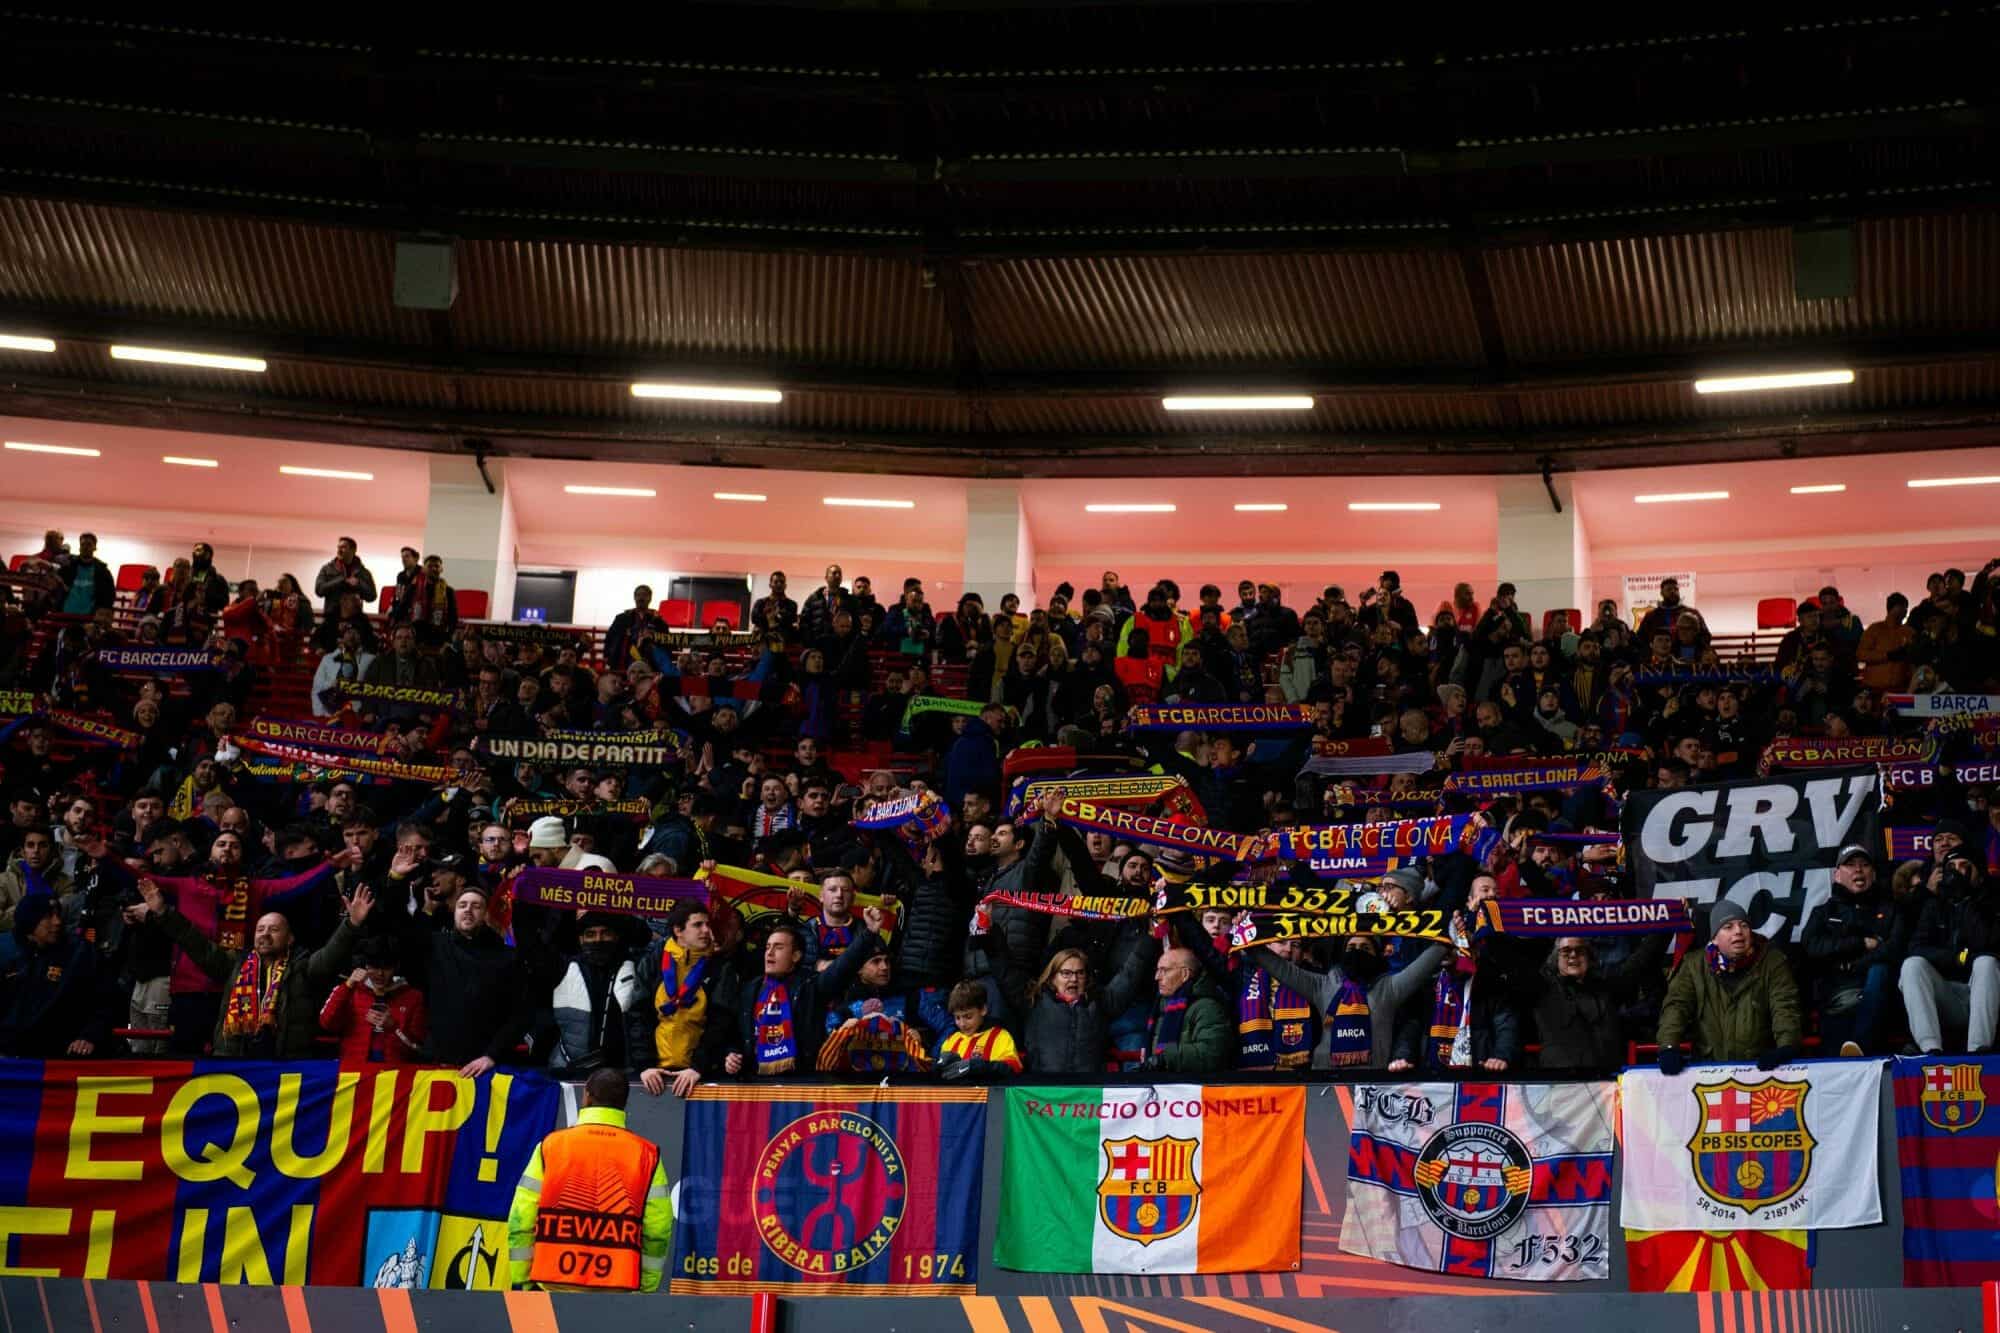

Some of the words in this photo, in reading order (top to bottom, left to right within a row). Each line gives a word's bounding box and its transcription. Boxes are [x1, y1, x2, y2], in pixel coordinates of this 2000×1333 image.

[120, 651, 209, 666] BARCELONA
[1931, 695, 1989, 712] BARÇA
[256, 721, 378, 748] CBARCELONA
[490, 739, 519, 756] UN
[522, 740, 559, 759] DIA
[561, 742, 590, 761] DE
[593, 743, 668, 764] PARTIT
[1061, 798, 1238, 851] CBARCELONA
[1640, 773, 1877, 864] GRV
[1289, 823, 1453, 850] FCBARCELONA
[583, 875, 635, 894] BARÇA
[540, 885, 573, 904] MÉS
[576, 890, 607, 907] QUE
[610, 894, 633, 910] UN
[1071, 895, 1151, 917] BARCELON
[1279, 886, 1351, 914] 532
[1371, 909, 1444, 937] 532
[1522, 906, 1547, 925] FC
[1551, 903, 1670, 925] BARCELONA
[1336, 1027, 1366, 1039] BARÇA
[763, 1045, 789, 1058] BARÇA
[1242, 1043, 1270, 1055] BARÇA
[1025, 1099, 1138, 1120] PATRICIO
[1144, 1096, 1283, 1119] O'CONNELL
[1357, 1087, 1435, 1125] FCB
[63, 1069, 515, 1190] EQUIP!
[1701, 1136, 1722, 1149] PB
[1724, 1136, 1747, 1149] SIS
[1751, 1134, 1803, 1149] COPES
[762, 1131, 803, 1179] PENYA
[807, 1118, 899, 1175] BARCELONISTA
[1130, 1181, 1167, 1194] FCB
[1696, 1196, 1711, 1211] SR
[1711, 1205, 1737, 1221] 2014
[1763, 1205, 1788, 1221] 2187
[1788, 1195, 1809, 1213] MK
[534, 1213, 642, 1246] TEWAR
[761, 1214, 825, 1272] RIBERA
[834, 1215, 899, 1270] BAIXA
[1511, 1233, 1602, 1269] F532
[558, 1250, 613, 1278] 079
[683, 1251, 719, 1276] des
[727, 1252, 754, 1276] de
[903, 1254, 966, 1279] 1974
